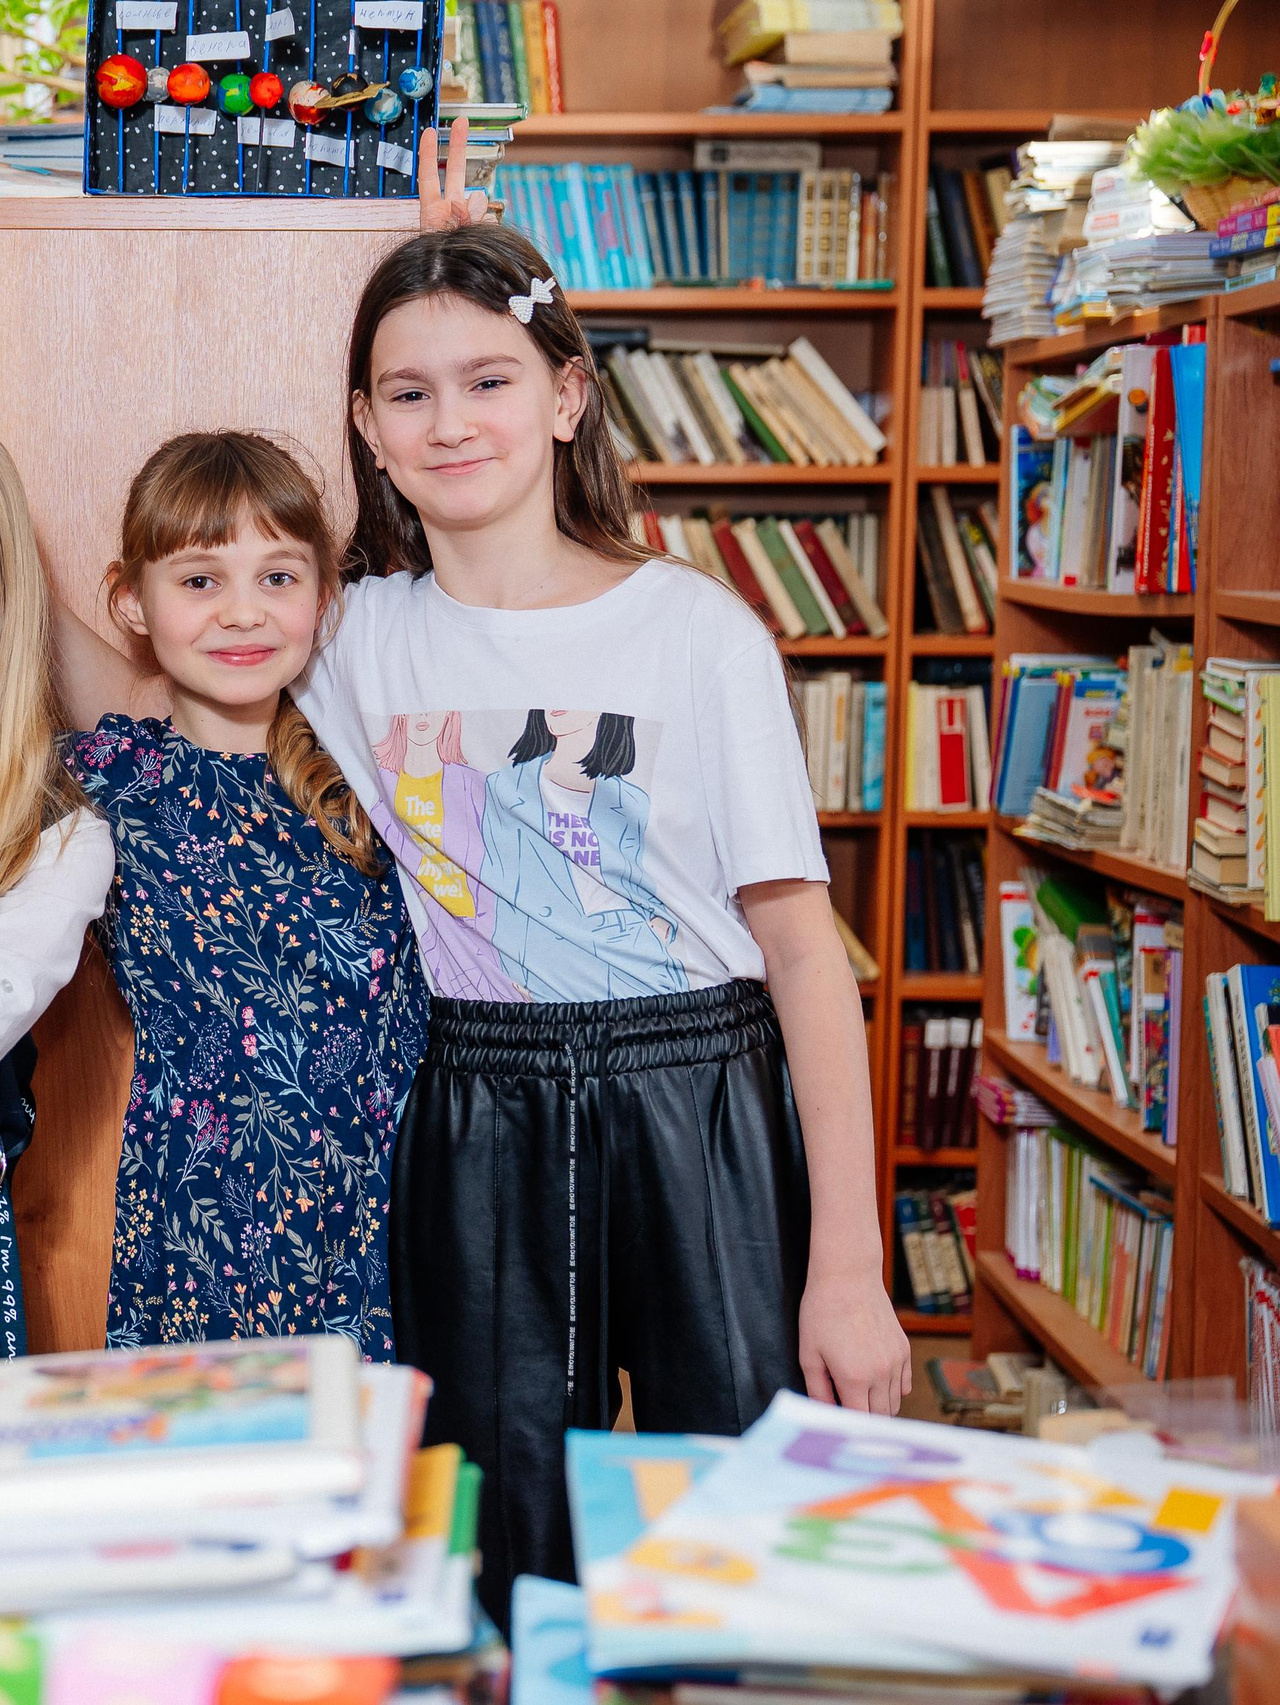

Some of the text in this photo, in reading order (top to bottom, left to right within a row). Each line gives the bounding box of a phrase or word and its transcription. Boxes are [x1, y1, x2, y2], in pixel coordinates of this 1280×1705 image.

[405, 795, 434, 816] The
[434, 880, 463, 897] we!
[0, 1235, 12, 1273] I'm
[1, 1279, 17, 1323] 99%
